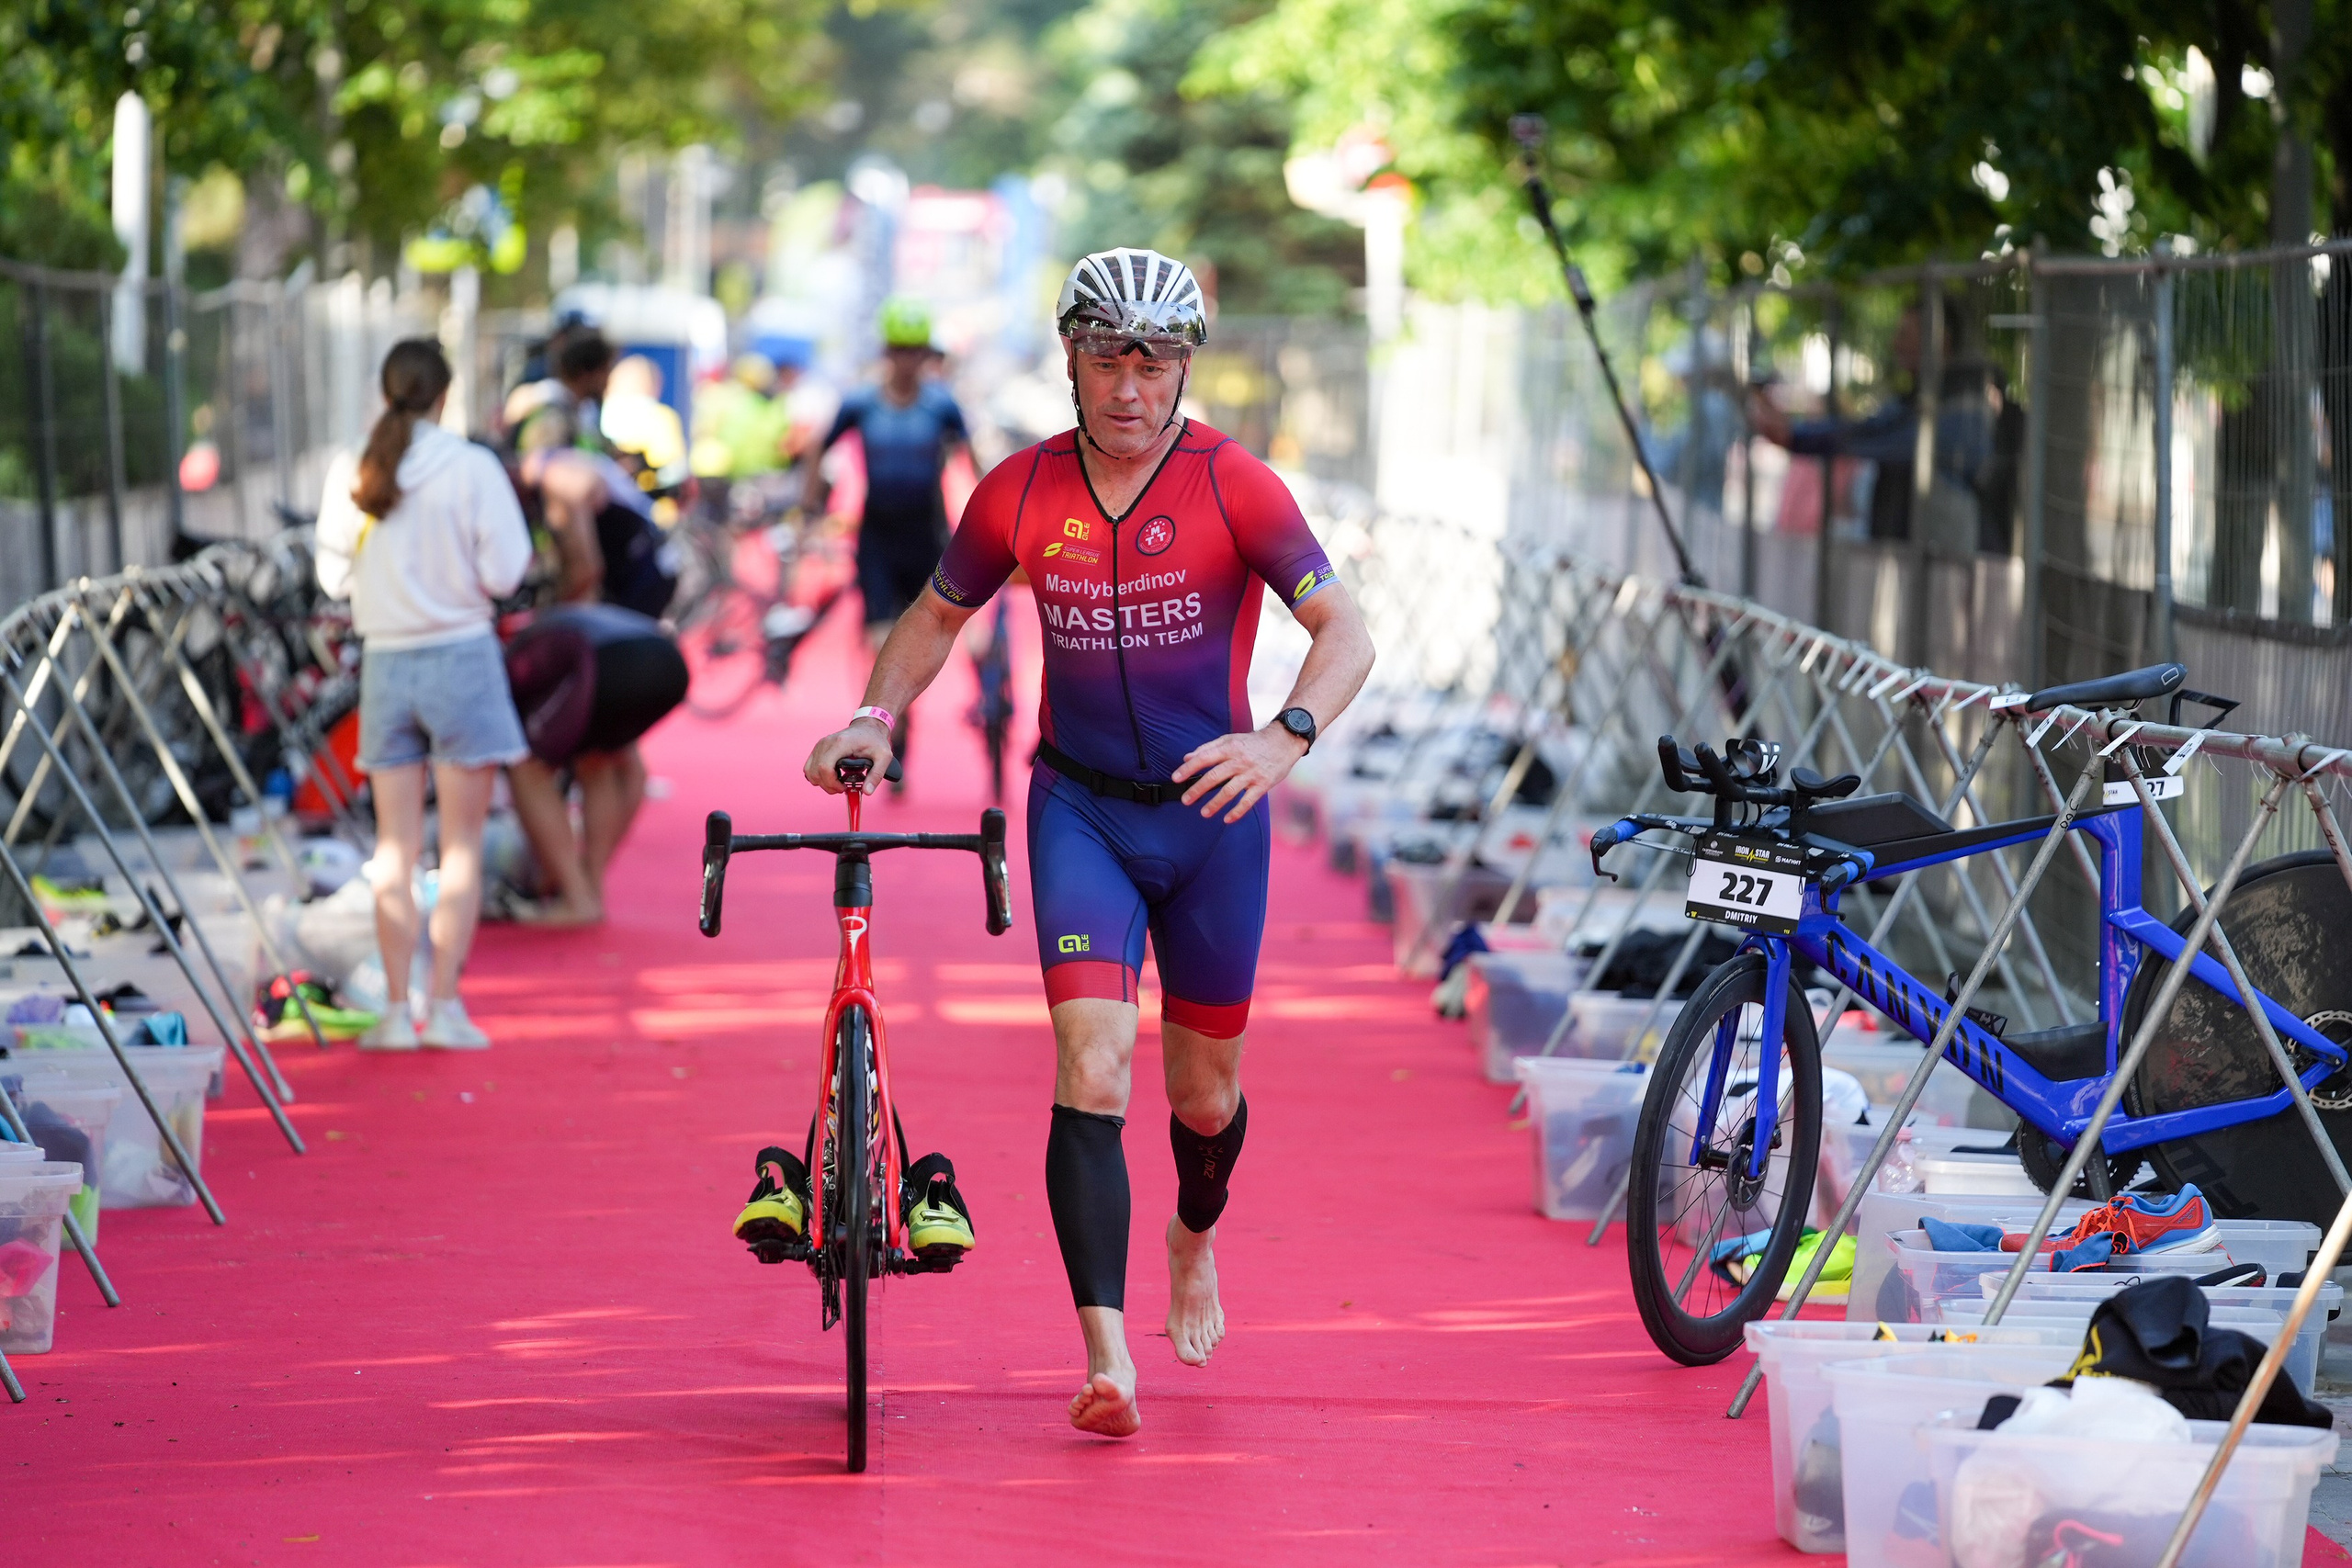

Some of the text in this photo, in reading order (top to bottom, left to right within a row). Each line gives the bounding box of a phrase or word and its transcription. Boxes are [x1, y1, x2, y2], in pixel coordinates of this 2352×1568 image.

[1061, 551, 1099, 564] TRIATHLON
[1063, 546, 1101, 558] SUPER LEAGUE
[942, 575, 969, 598] LEAGUE
[1046, 569, 1186, 600] Mavlyberdinov
[1043, 592, 1202, 631] MASTERS
[1051, 622, 1204, 651] TRIATHLON TEAM
[2146, 781, 2165, 796] 27
[1735, 845, 1750, 855] IRON
[1755, 848, 1770, 859] STAR
[1719, 872, 1773, 907] 227
[1724, 910, 1758, 924] DMITRIY
[1826, 930, 2004, 1095] CANYON
[1204, 1158, 1216, 1179] 2XU
